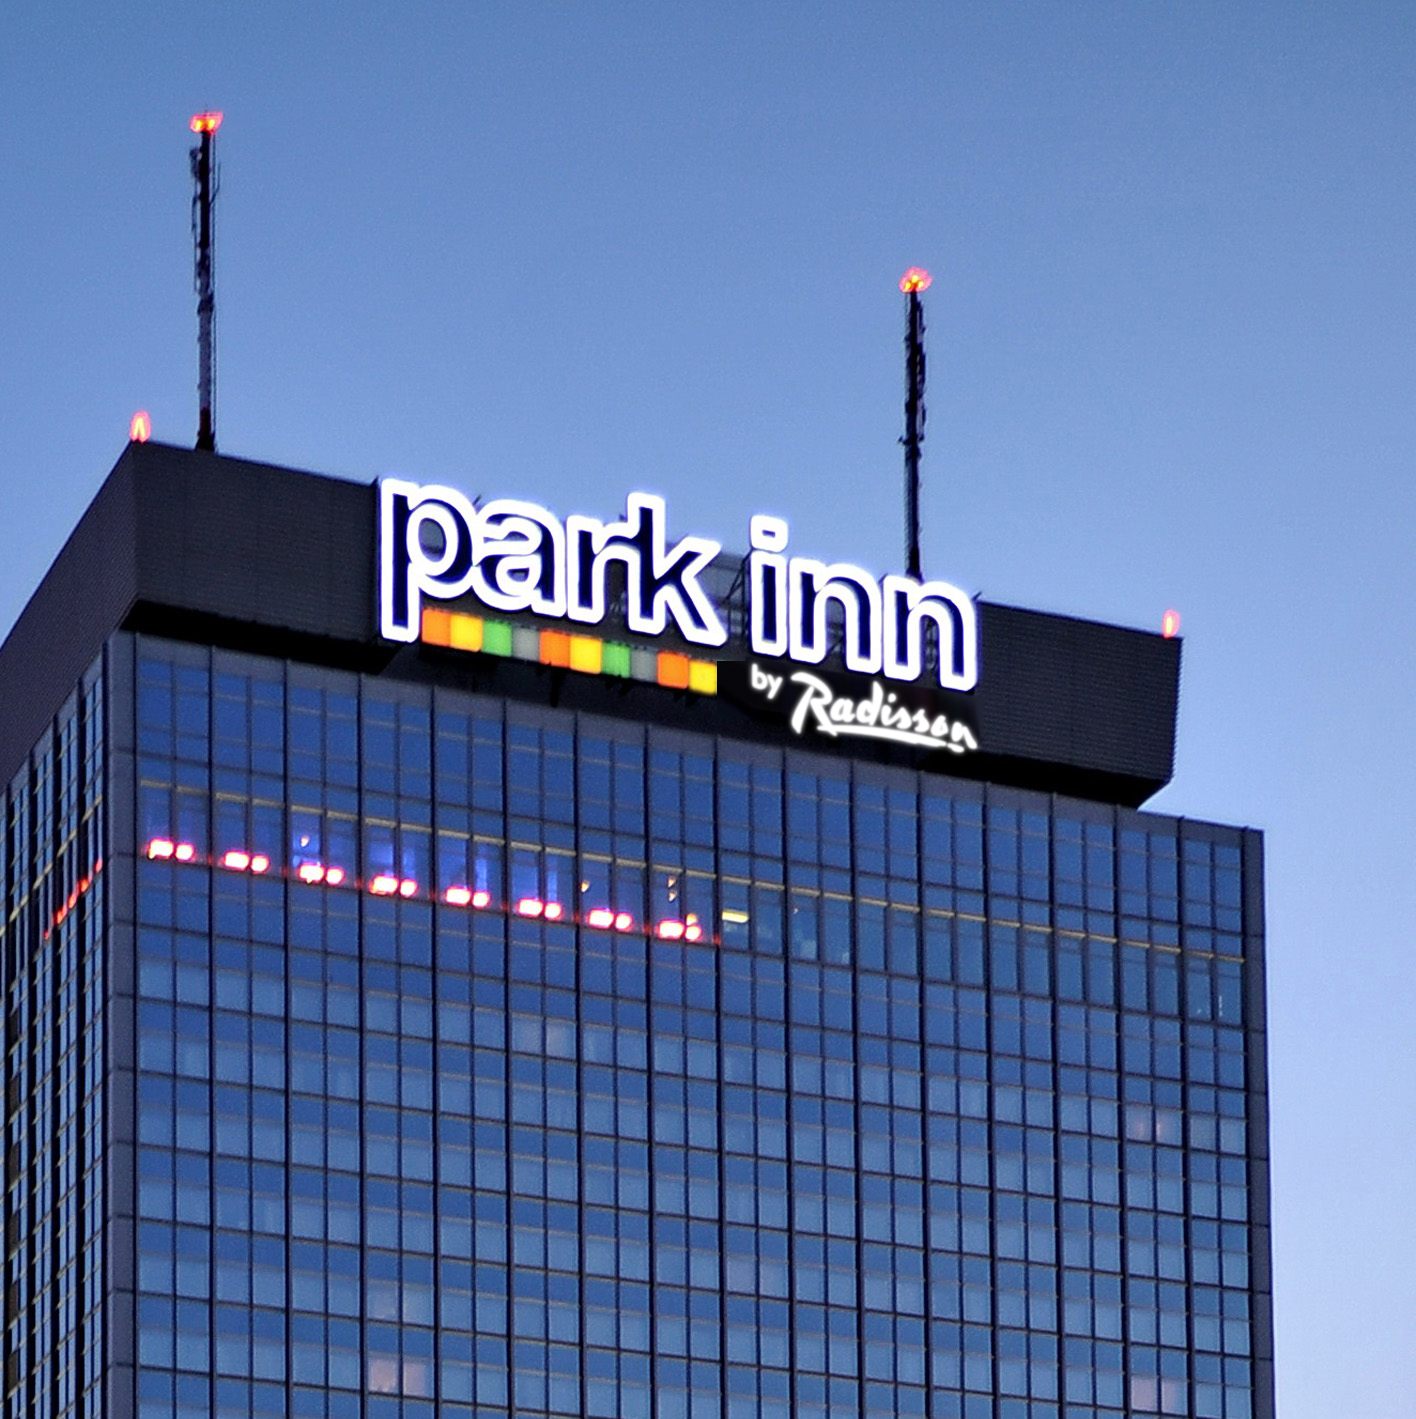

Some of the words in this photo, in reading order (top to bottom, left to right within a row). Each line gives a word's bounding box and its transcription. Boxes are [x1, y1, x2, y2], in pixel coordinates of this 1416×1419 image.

[381, 477, 727, 647] park
[749, 514, 978, 691] inn
[750, 663, 783, 700] by
[790, 671, 978, 753] Radisson
